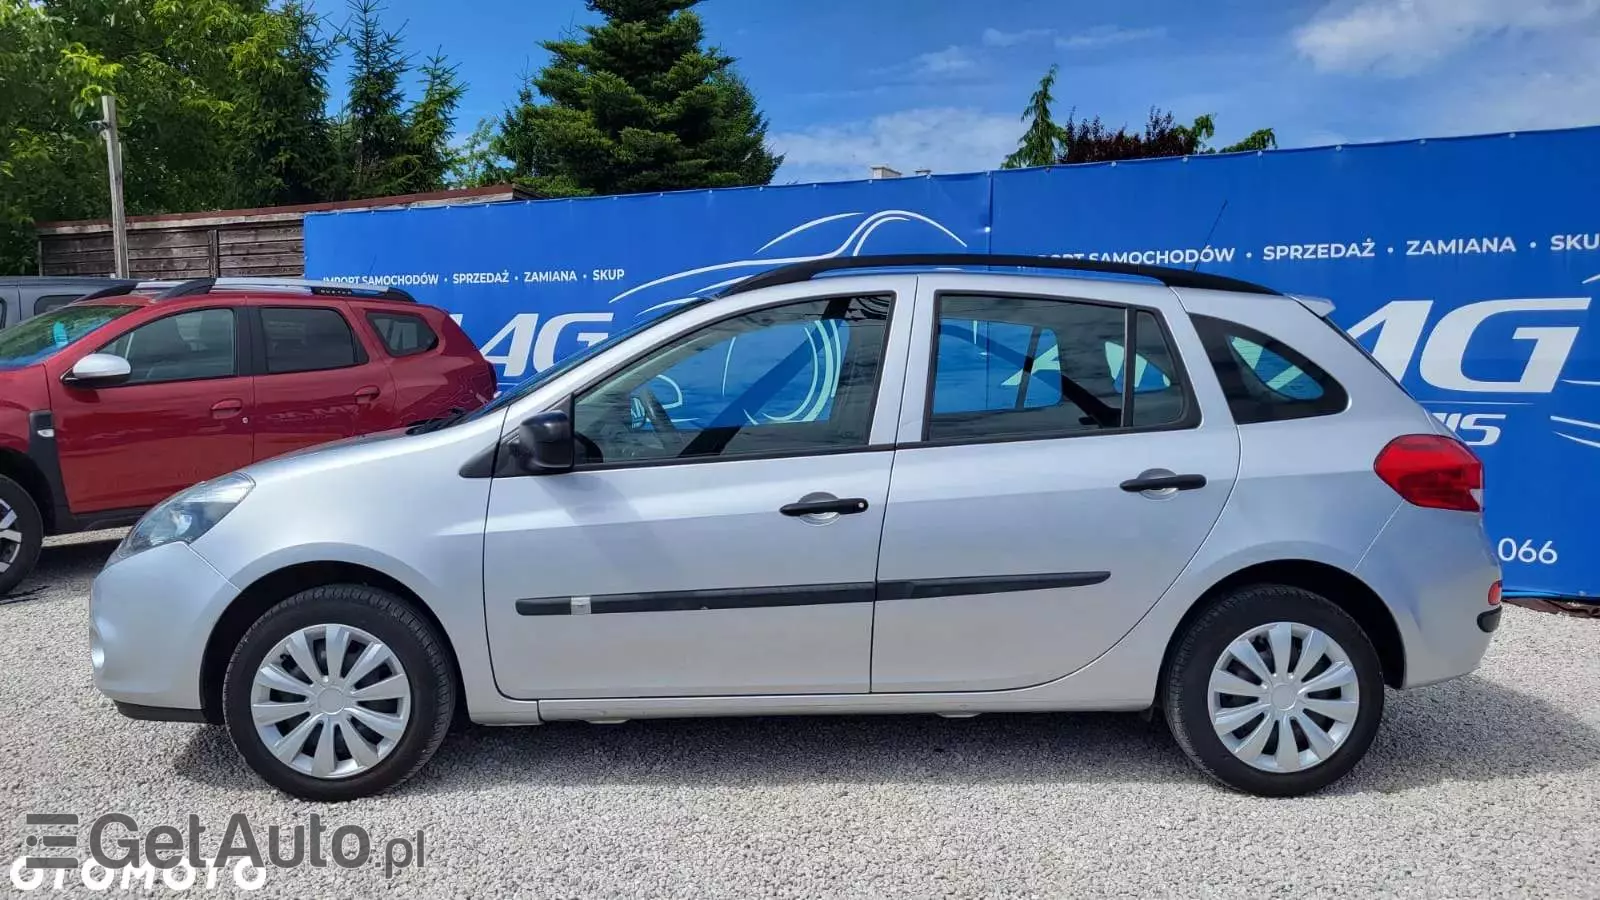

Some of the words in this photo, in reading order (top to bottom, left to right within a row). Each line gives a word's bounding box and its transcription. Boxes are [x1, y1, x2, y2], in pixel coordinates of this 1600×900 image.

[1263, 238, 1376, 260] SPRZEDAŻ
[1406, 236, 1517, 256] ZAMIANA
[1550, 233, 1600, 250] SKU
[453, 269, 509, 283] SPRZEDAŻ
[523, 270, 577, 283] ZAMIANA
[592, 268, 625, 281] SKUP
[1498, 537, 1558, 565] 066
